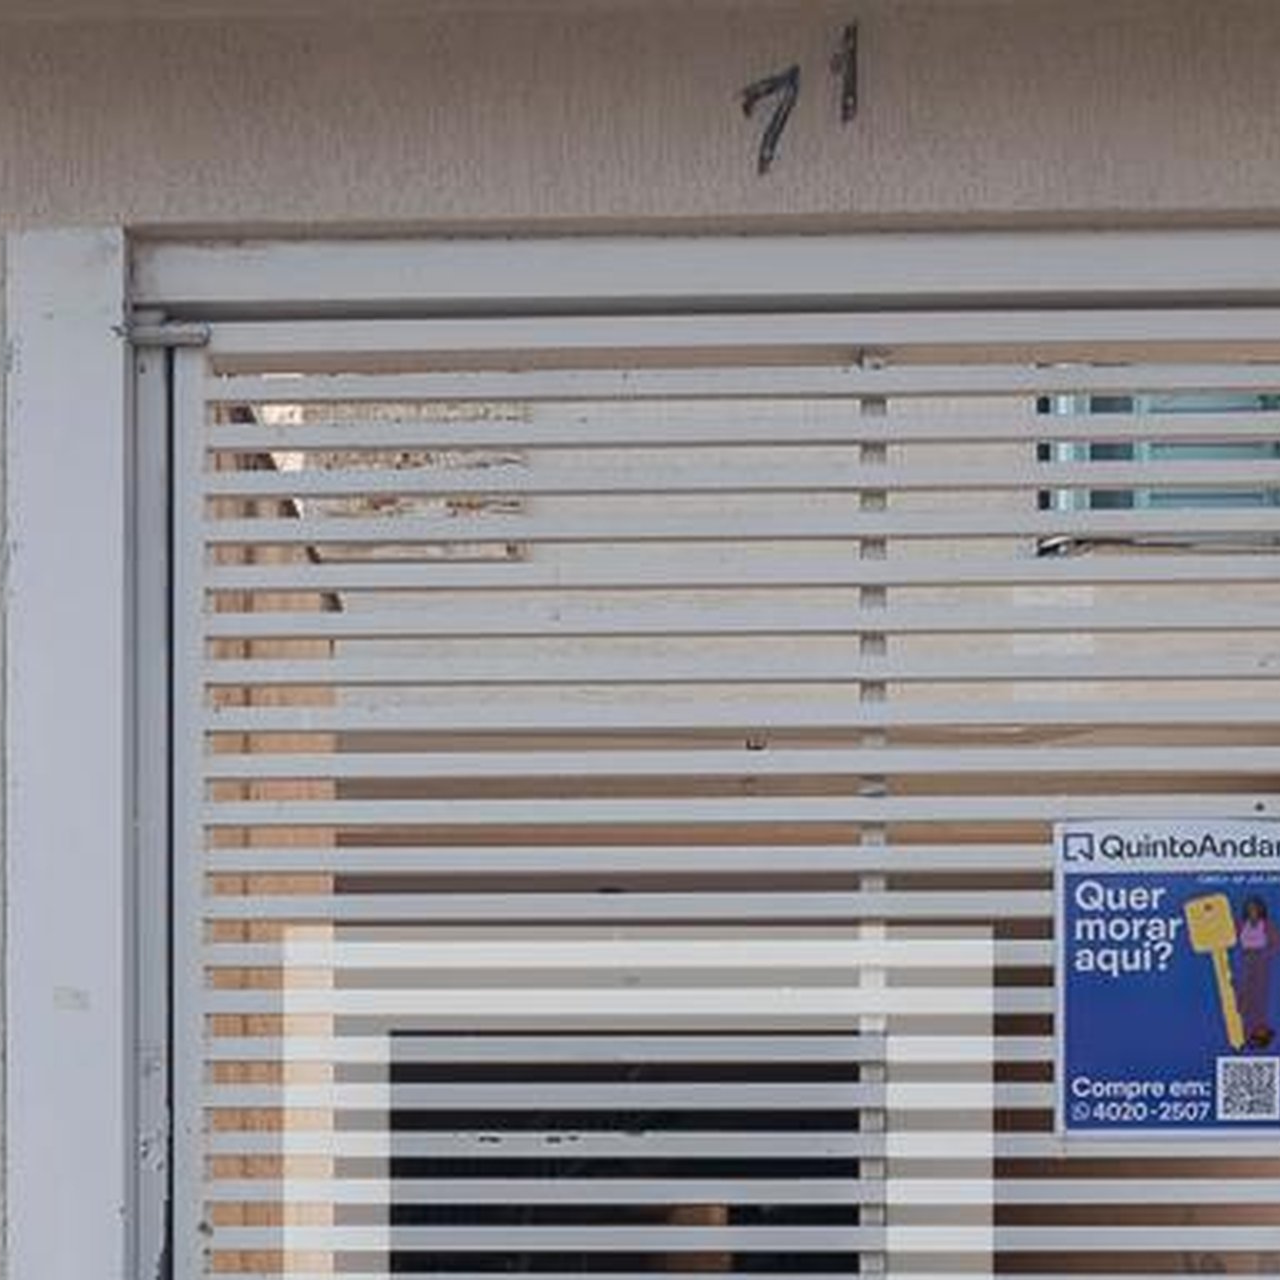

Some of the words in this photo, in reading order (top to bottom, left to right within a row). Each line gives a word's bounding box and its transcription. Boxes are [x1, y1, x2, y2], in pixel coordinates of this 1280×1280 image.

[740, 20, 858, 175] 71
[1075, 880, 1166, 911] Quer
[1075, 916, 1183, 940] morar
[1075, 942, 1173, 977] aqui?
[1072, 1076, 1164, 1100] Compre
[1169, 1081, 1211, 1097] em:
[1092, 1101, 1210, 1121] 4020-2507
